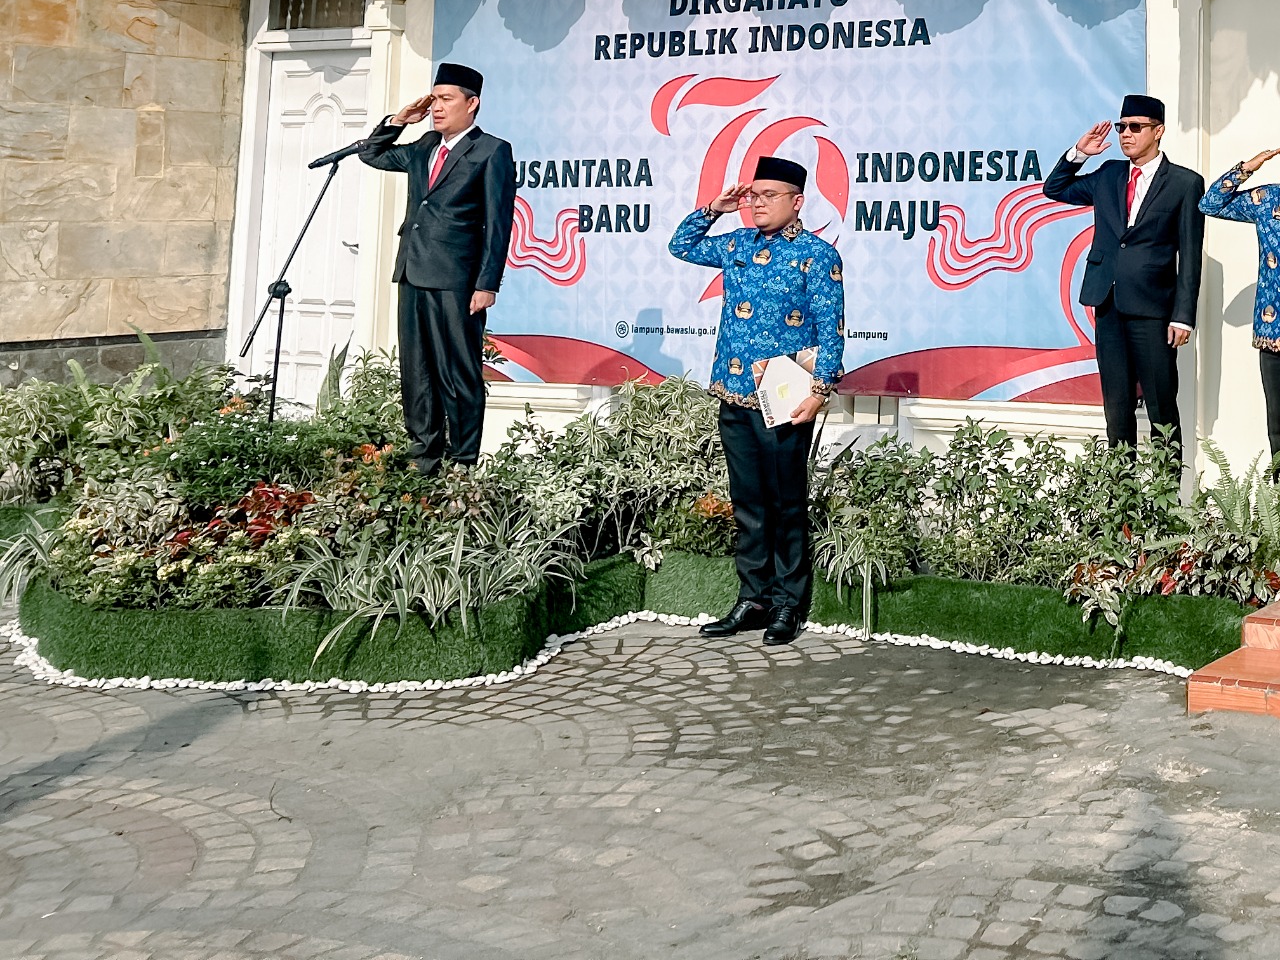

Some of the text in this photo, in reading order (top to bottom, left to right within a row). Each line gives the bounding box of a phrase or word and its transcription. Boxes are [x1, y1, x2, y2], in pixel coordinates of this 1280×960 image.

[594, 17, 932, 61] REPUBLIK INDONESIA
[513, 158, 653, 188] USANTARA
[856, 150, 1042, 183] INDONESIA
[579, 203, 651, 233] BARU
[855, 200, 940, 240] MAJU
[631, 324, 717, 337] lampung.bawaslu.go.id
[847, 329, 888, 341] Lampung
